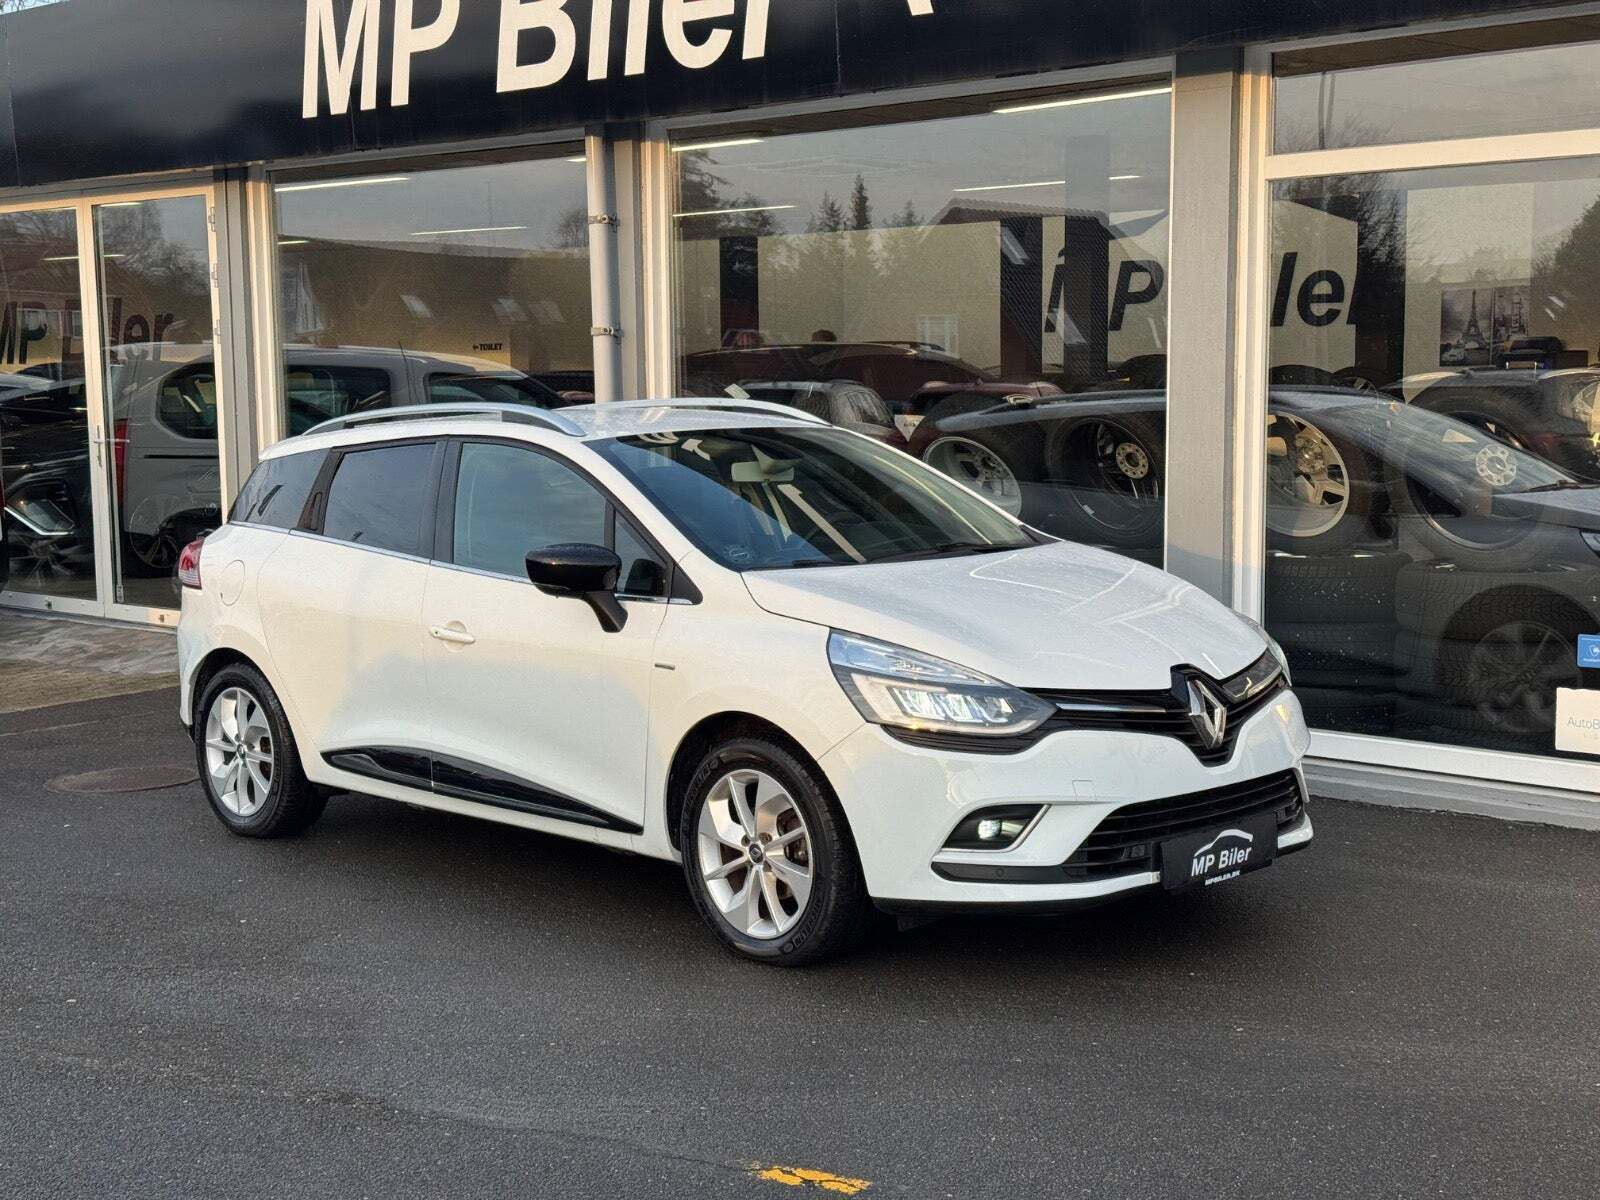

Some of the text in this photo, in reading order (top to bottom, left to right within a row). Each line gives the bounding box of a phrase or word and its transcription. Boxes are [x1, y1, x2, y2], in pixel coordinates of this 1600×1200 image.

[302, 0, 459, 119] MP
[479, 343, 503, 351] TOILET
[1191, 847, 1252, 877] MP Biler
